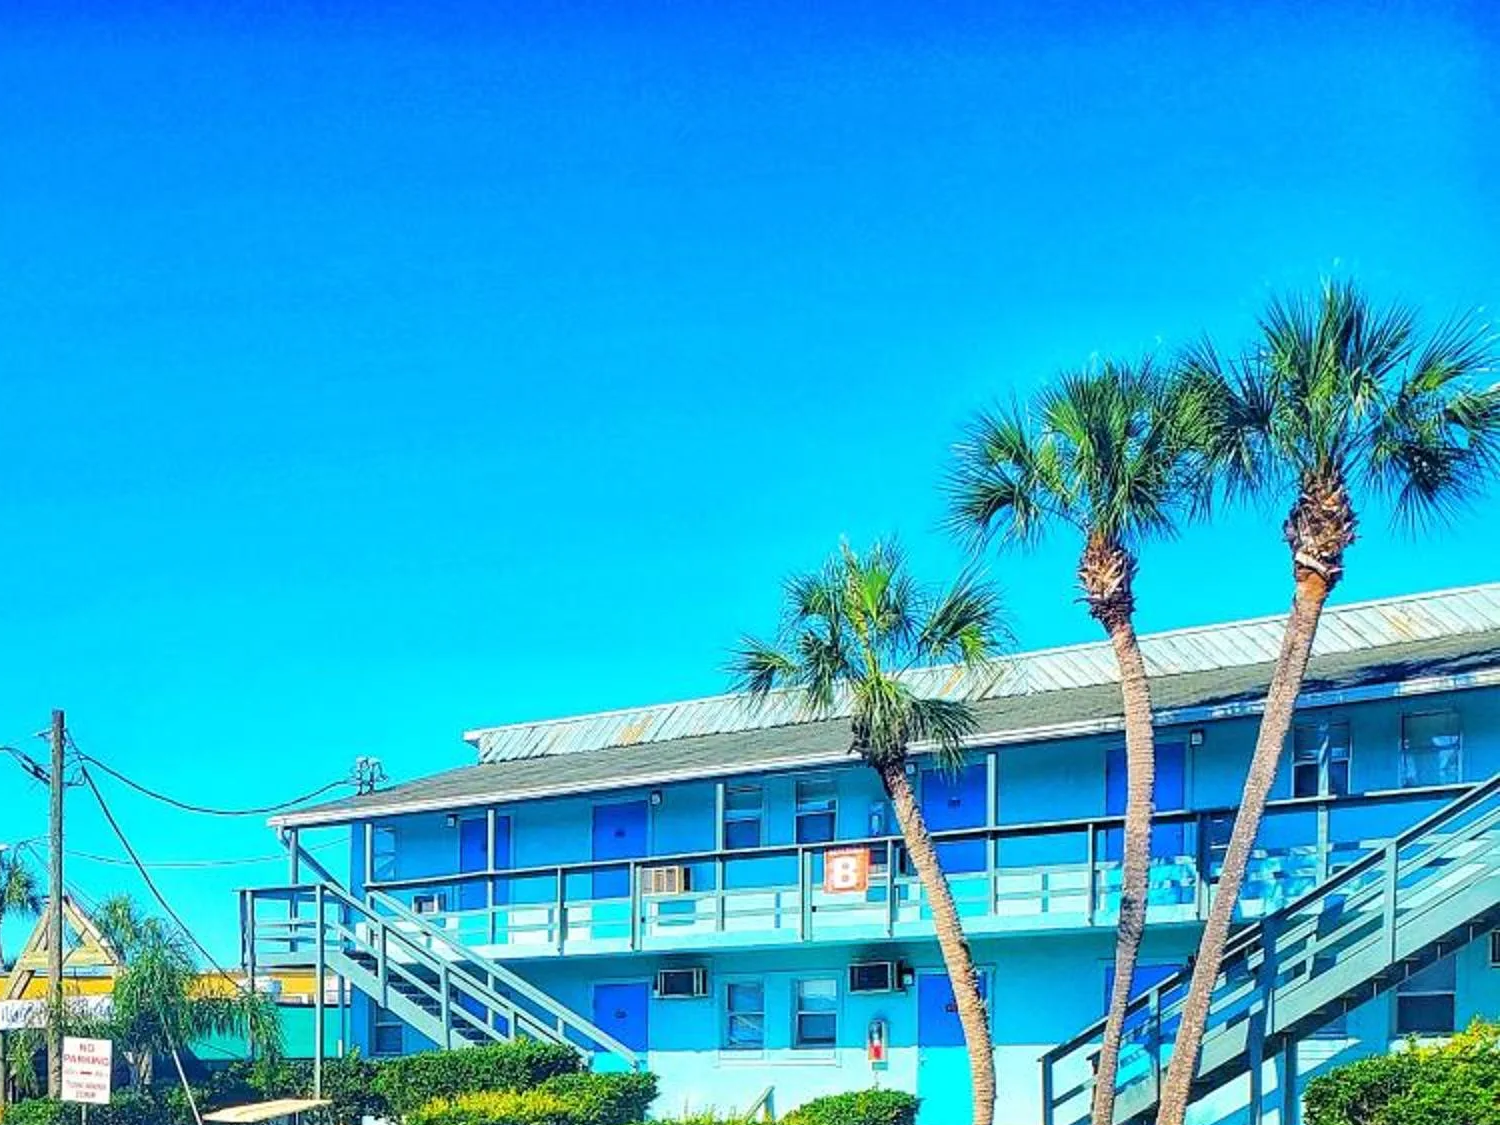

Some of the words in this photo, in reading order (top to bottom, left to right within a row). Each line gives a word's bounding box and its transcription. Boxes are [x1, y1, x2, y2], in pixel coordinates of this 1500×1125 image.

[832, 855, 857, 889] B
[79, 1043, 95, 1053] NO
[63, 1053, 109, 1067] PARKING
